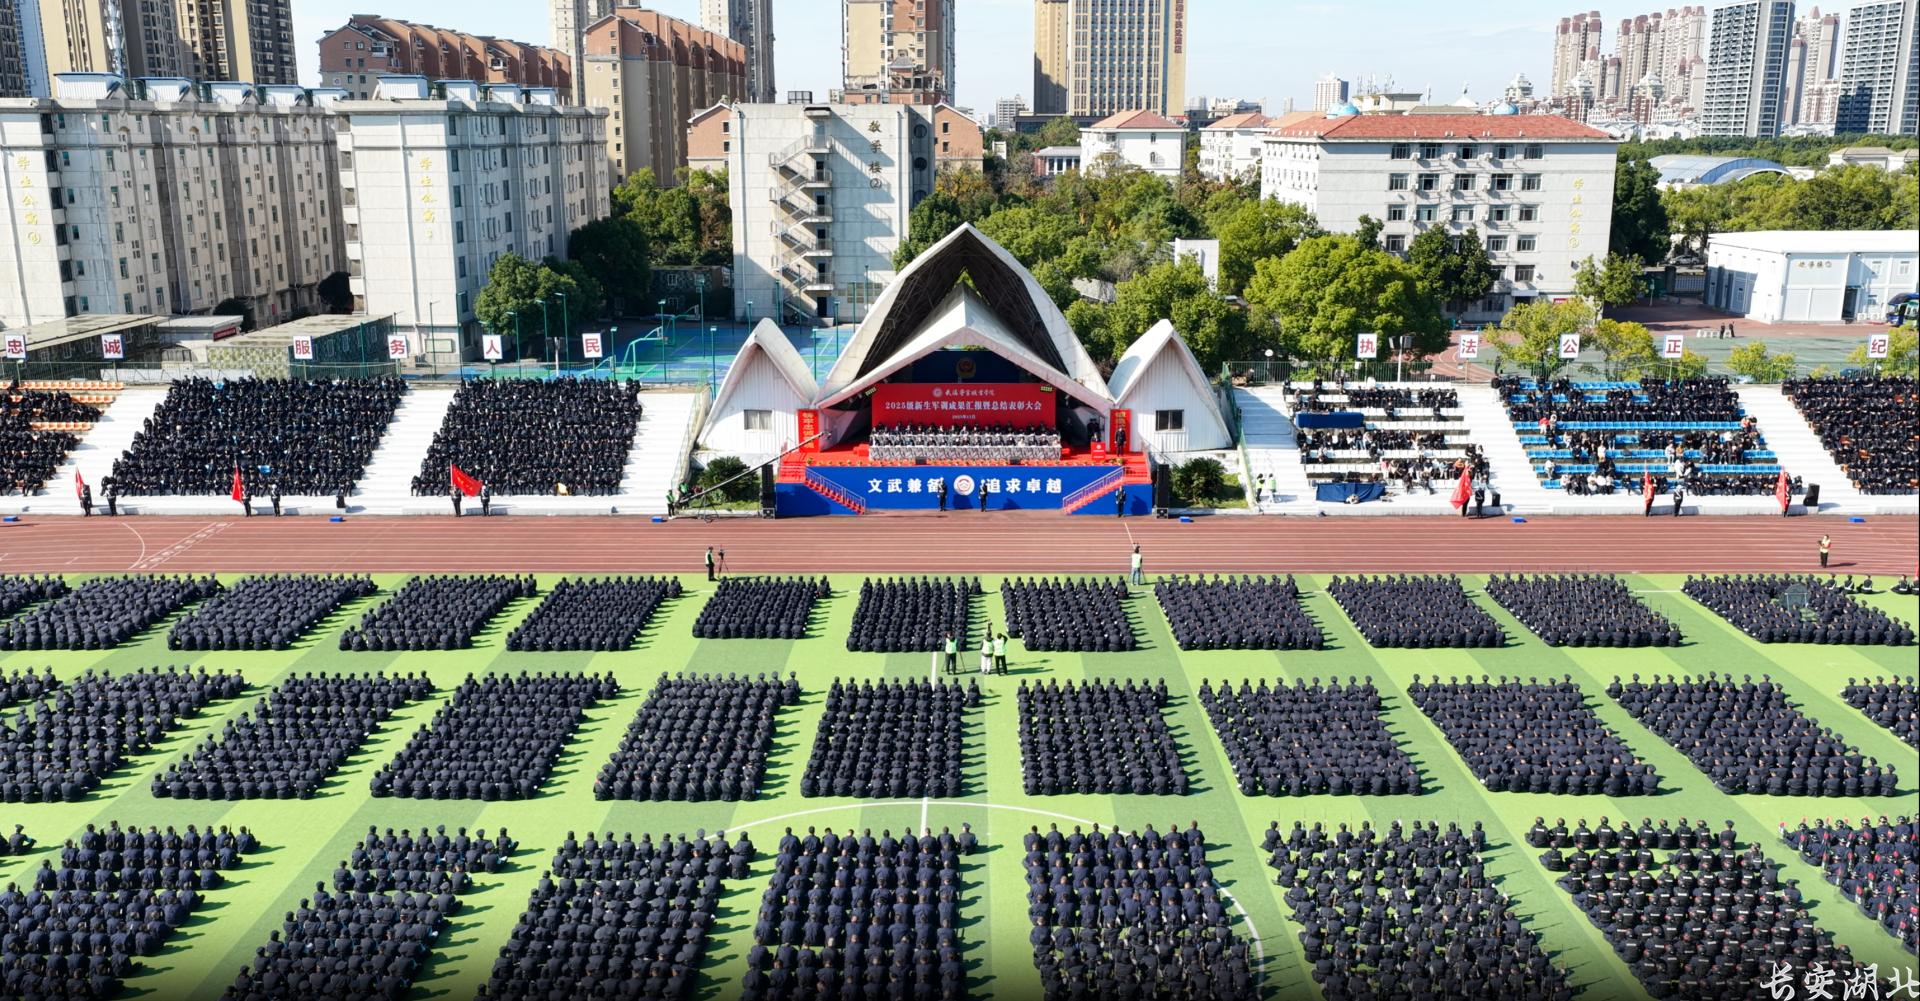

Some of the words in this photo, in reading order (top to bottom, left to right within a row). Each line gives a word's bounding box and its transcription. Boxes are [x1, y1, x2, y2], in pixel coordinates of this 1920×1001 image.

[7, 339, 24, 355] 忠
[103, 339, 121, 355] 诚
[295, 340, 311, 355] 服
[389, 339, 406, 354] 务
[485, 340, 500, 355] 人
[585, 338, 600, 353] 民
[1359, 338, 1375, 354] 执
[1461, 338, 1476, 354] 法
[1563, 338, 1578, 354] 公
[1666, 339, 1681, 354] 正
[1871, 339, 1887, 354] 纪
[885, 401, 1042, 411] 2025级新生军训成果汇报暨总结表彰大会
[868, 478, 942, 493] 文武兼备
[984, 478, 1062, 494] 追求卓越
